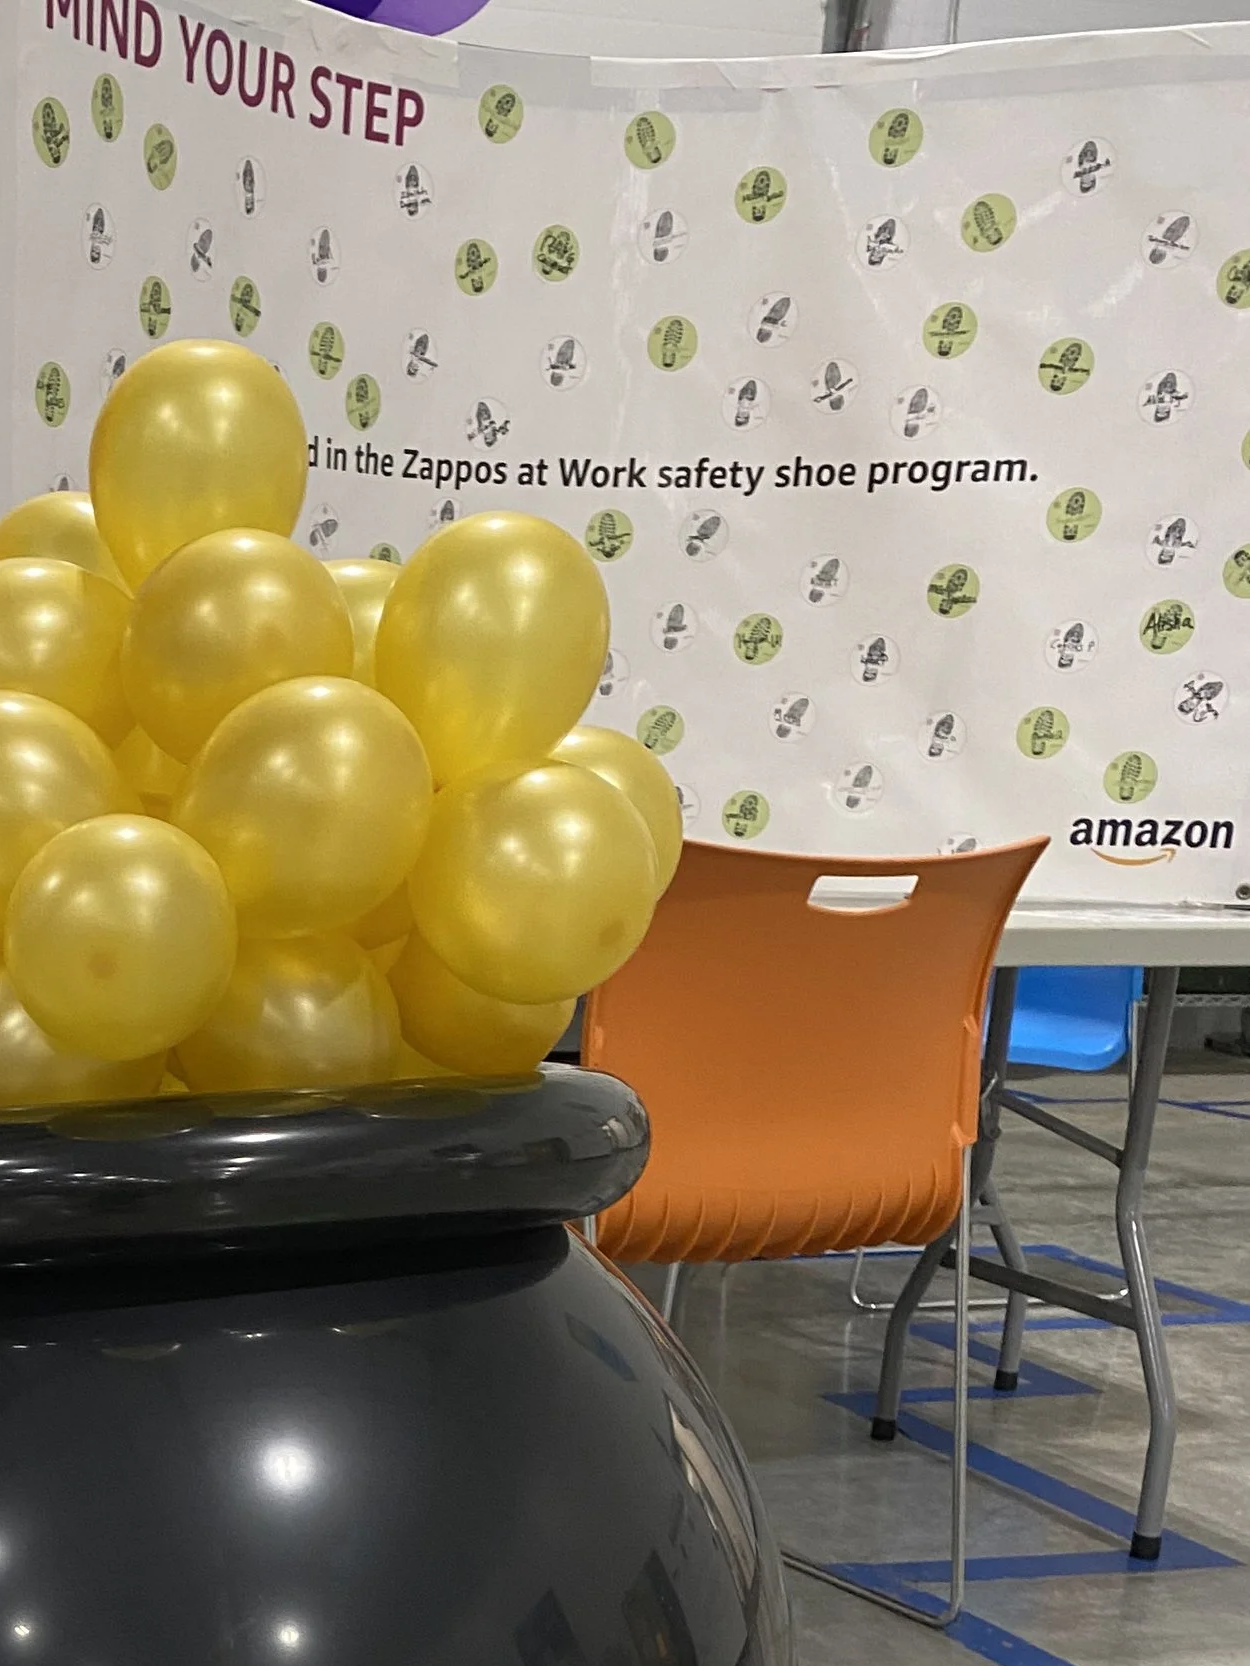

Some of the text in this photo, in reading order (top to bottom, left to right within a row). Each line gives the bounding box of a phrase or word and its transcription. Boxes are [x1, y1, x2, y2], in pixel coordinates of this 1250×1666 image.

[178, 15, 296, 118] YOUR
[310, 66, 425, 147] STEP
[326, 437, 347, 472] in
[355, 442, 394, 477] the
[401, 448, 508, 491] Zappos
[517, 458, 549, 487] at
[559, 457, 647, 488] Work
[657, 456, 764, 497] safety
[774, 455, 856, 488] shoe
[867, 458, 1039, 494] program.
[1069, 817, 1235, 850] amazon
